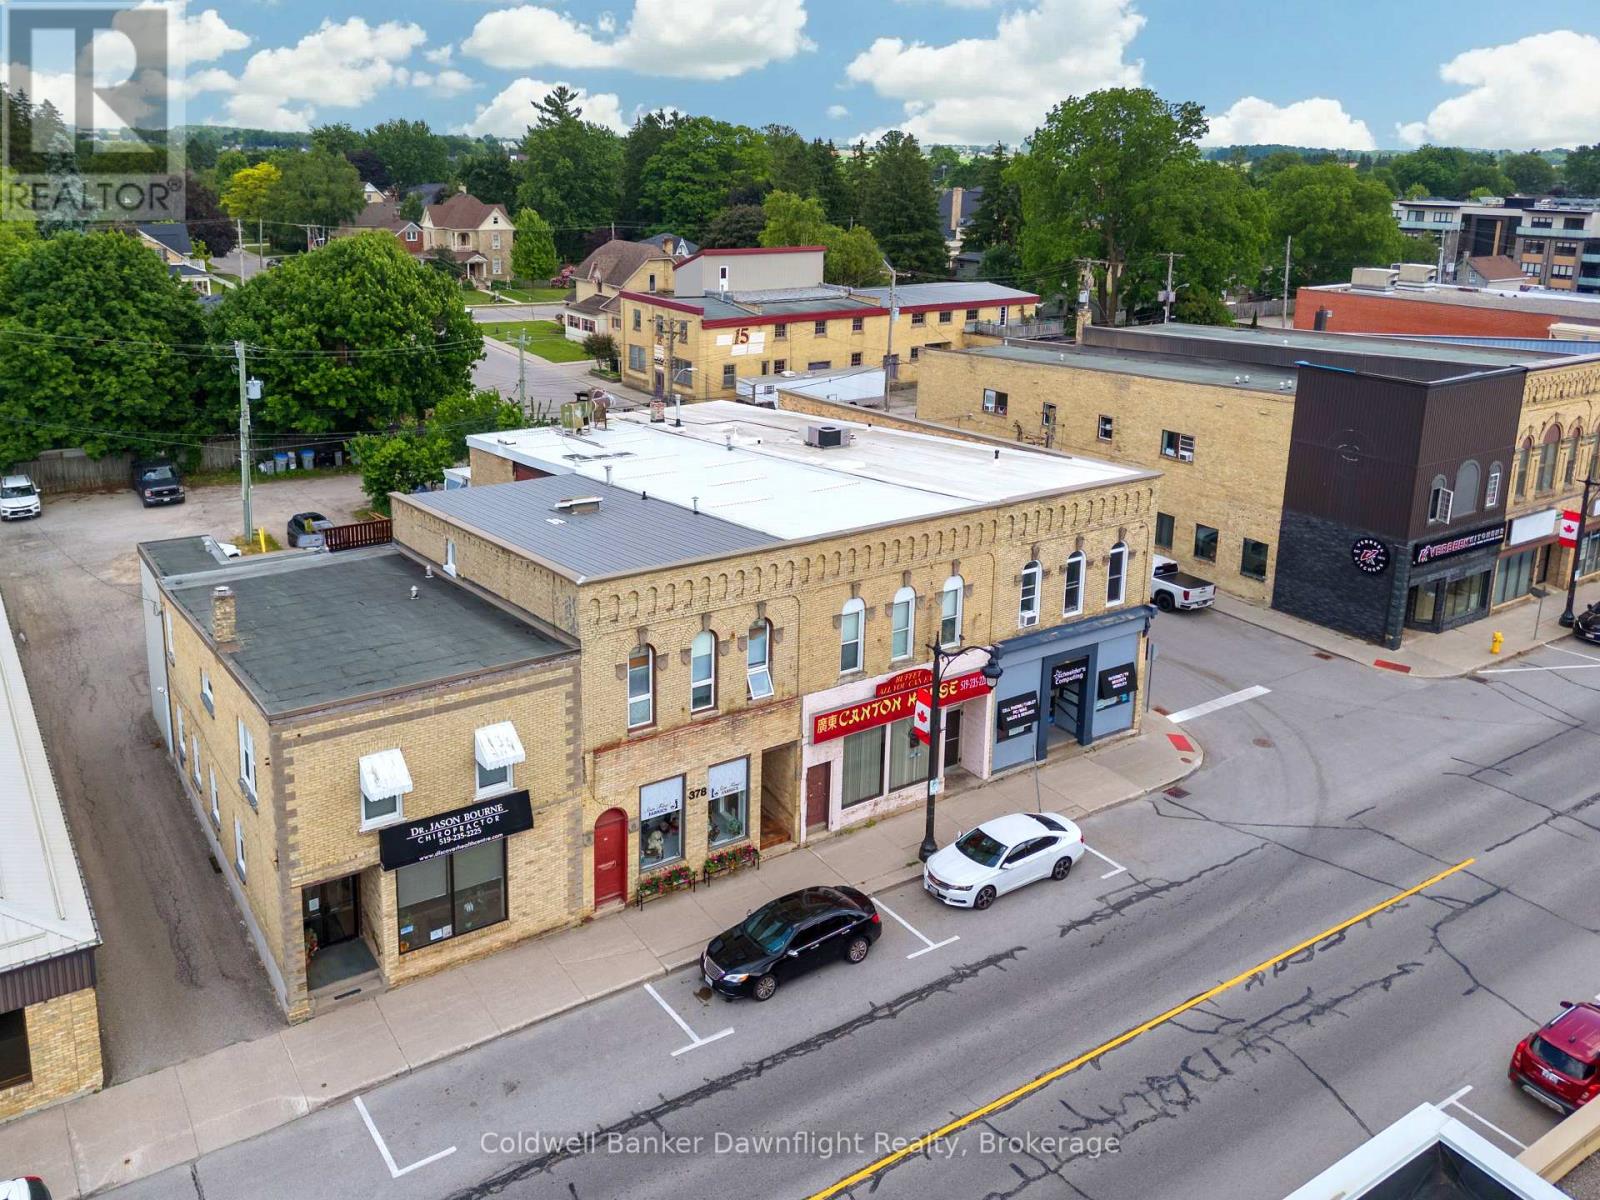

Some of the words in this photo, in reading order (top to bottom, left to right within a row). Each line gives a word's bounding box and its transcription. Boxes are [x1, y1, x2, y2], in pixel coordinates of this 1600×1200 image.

[735, 328, 749, 345] 15
[839, 696, 902, 727] CANTON
[907, 680, 959, 707] HSE
[688, 787, 707, 800] 378
[430, 815, 460, 831] JASON
[464, 804, 504, 821] BOURNE
[417, 815, 500, 844] CHIROPRACTOR
[439, 828, 482, 846] 519-235-2225
